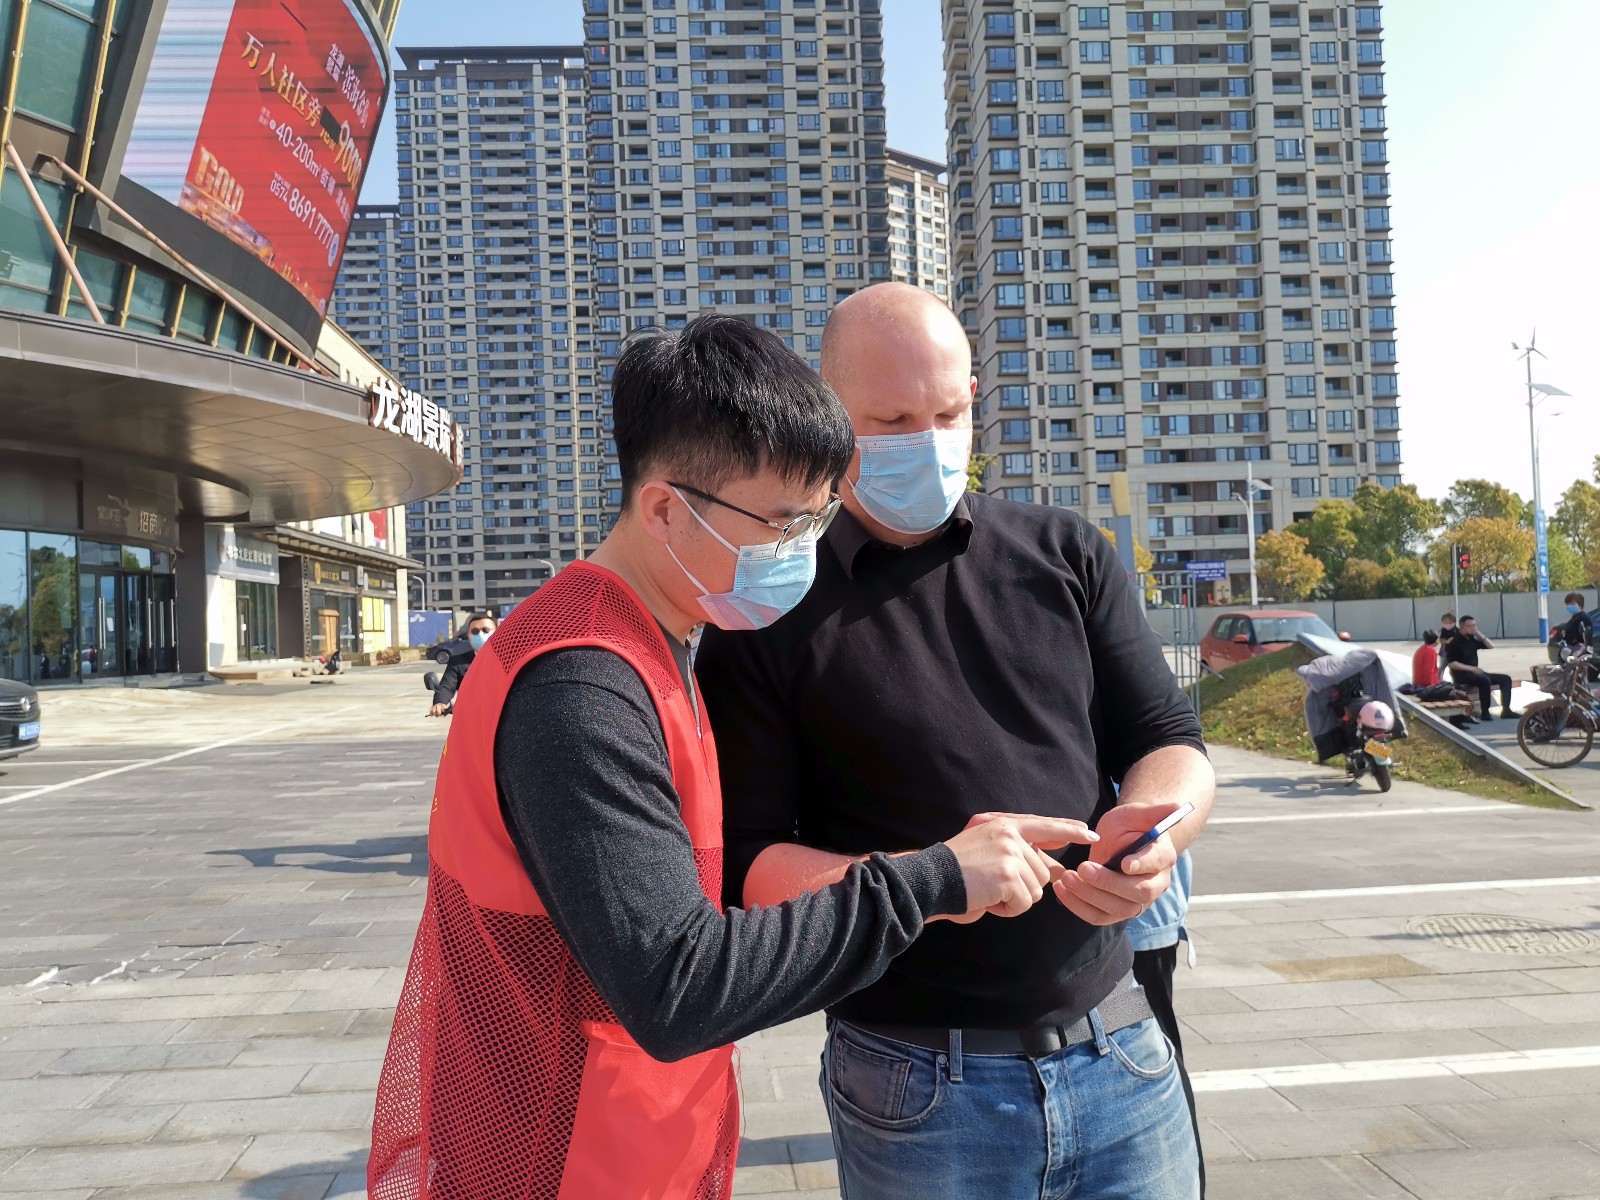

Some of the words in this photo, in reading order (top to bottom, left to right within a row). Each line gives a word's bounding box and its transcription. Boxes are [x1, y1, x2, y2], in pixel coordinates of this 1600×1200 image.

[241, 31, 321, 128] 万人社区旁
[373, 378, 464, 466] 龙湖景瑞
